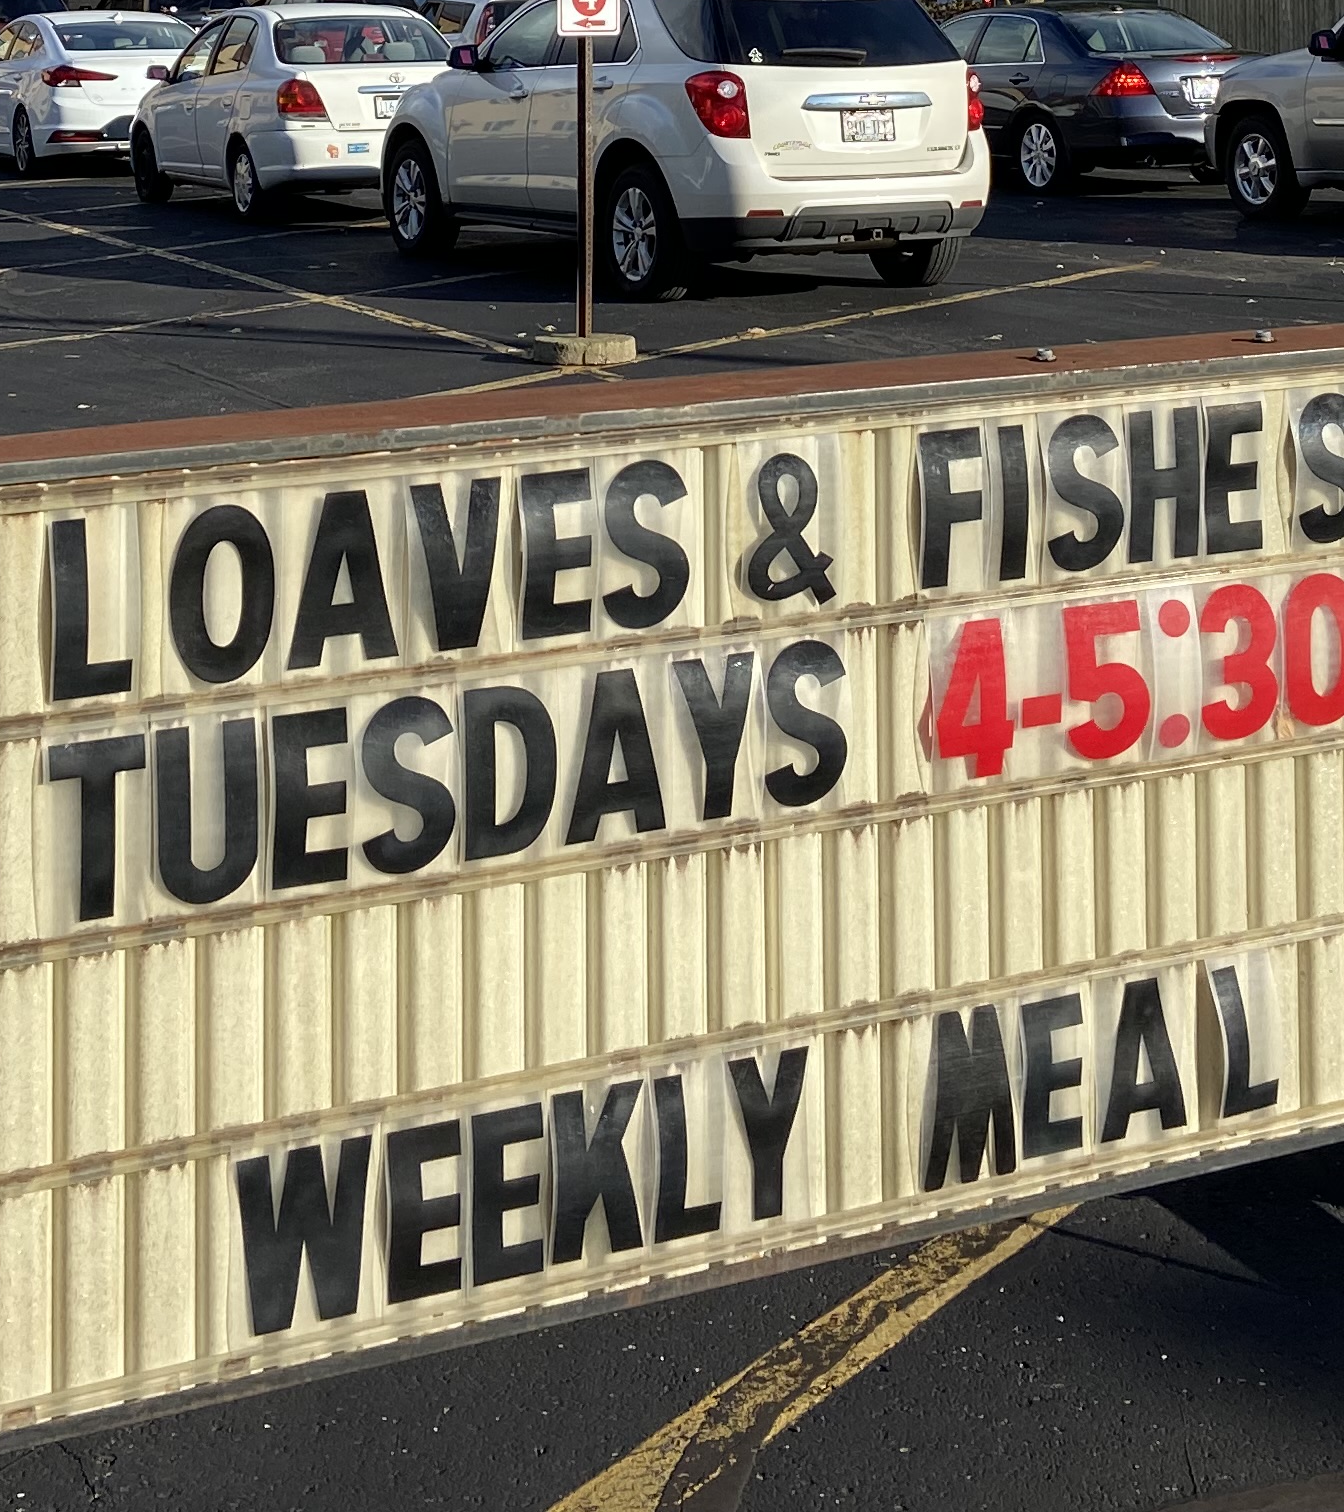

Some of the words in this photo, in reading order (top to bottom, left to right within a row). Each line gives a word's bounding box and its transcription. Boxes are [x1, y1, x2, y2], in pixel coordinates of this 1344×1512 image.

[52, 459, 690, 702] LOAVES
[747, 452, 837, 606] &
[48, 638, 848, 922] TUESDAYS
[236, 1045, 808, 1337] WEEKLY
[924, 966, 1278, 1192] MEAL
